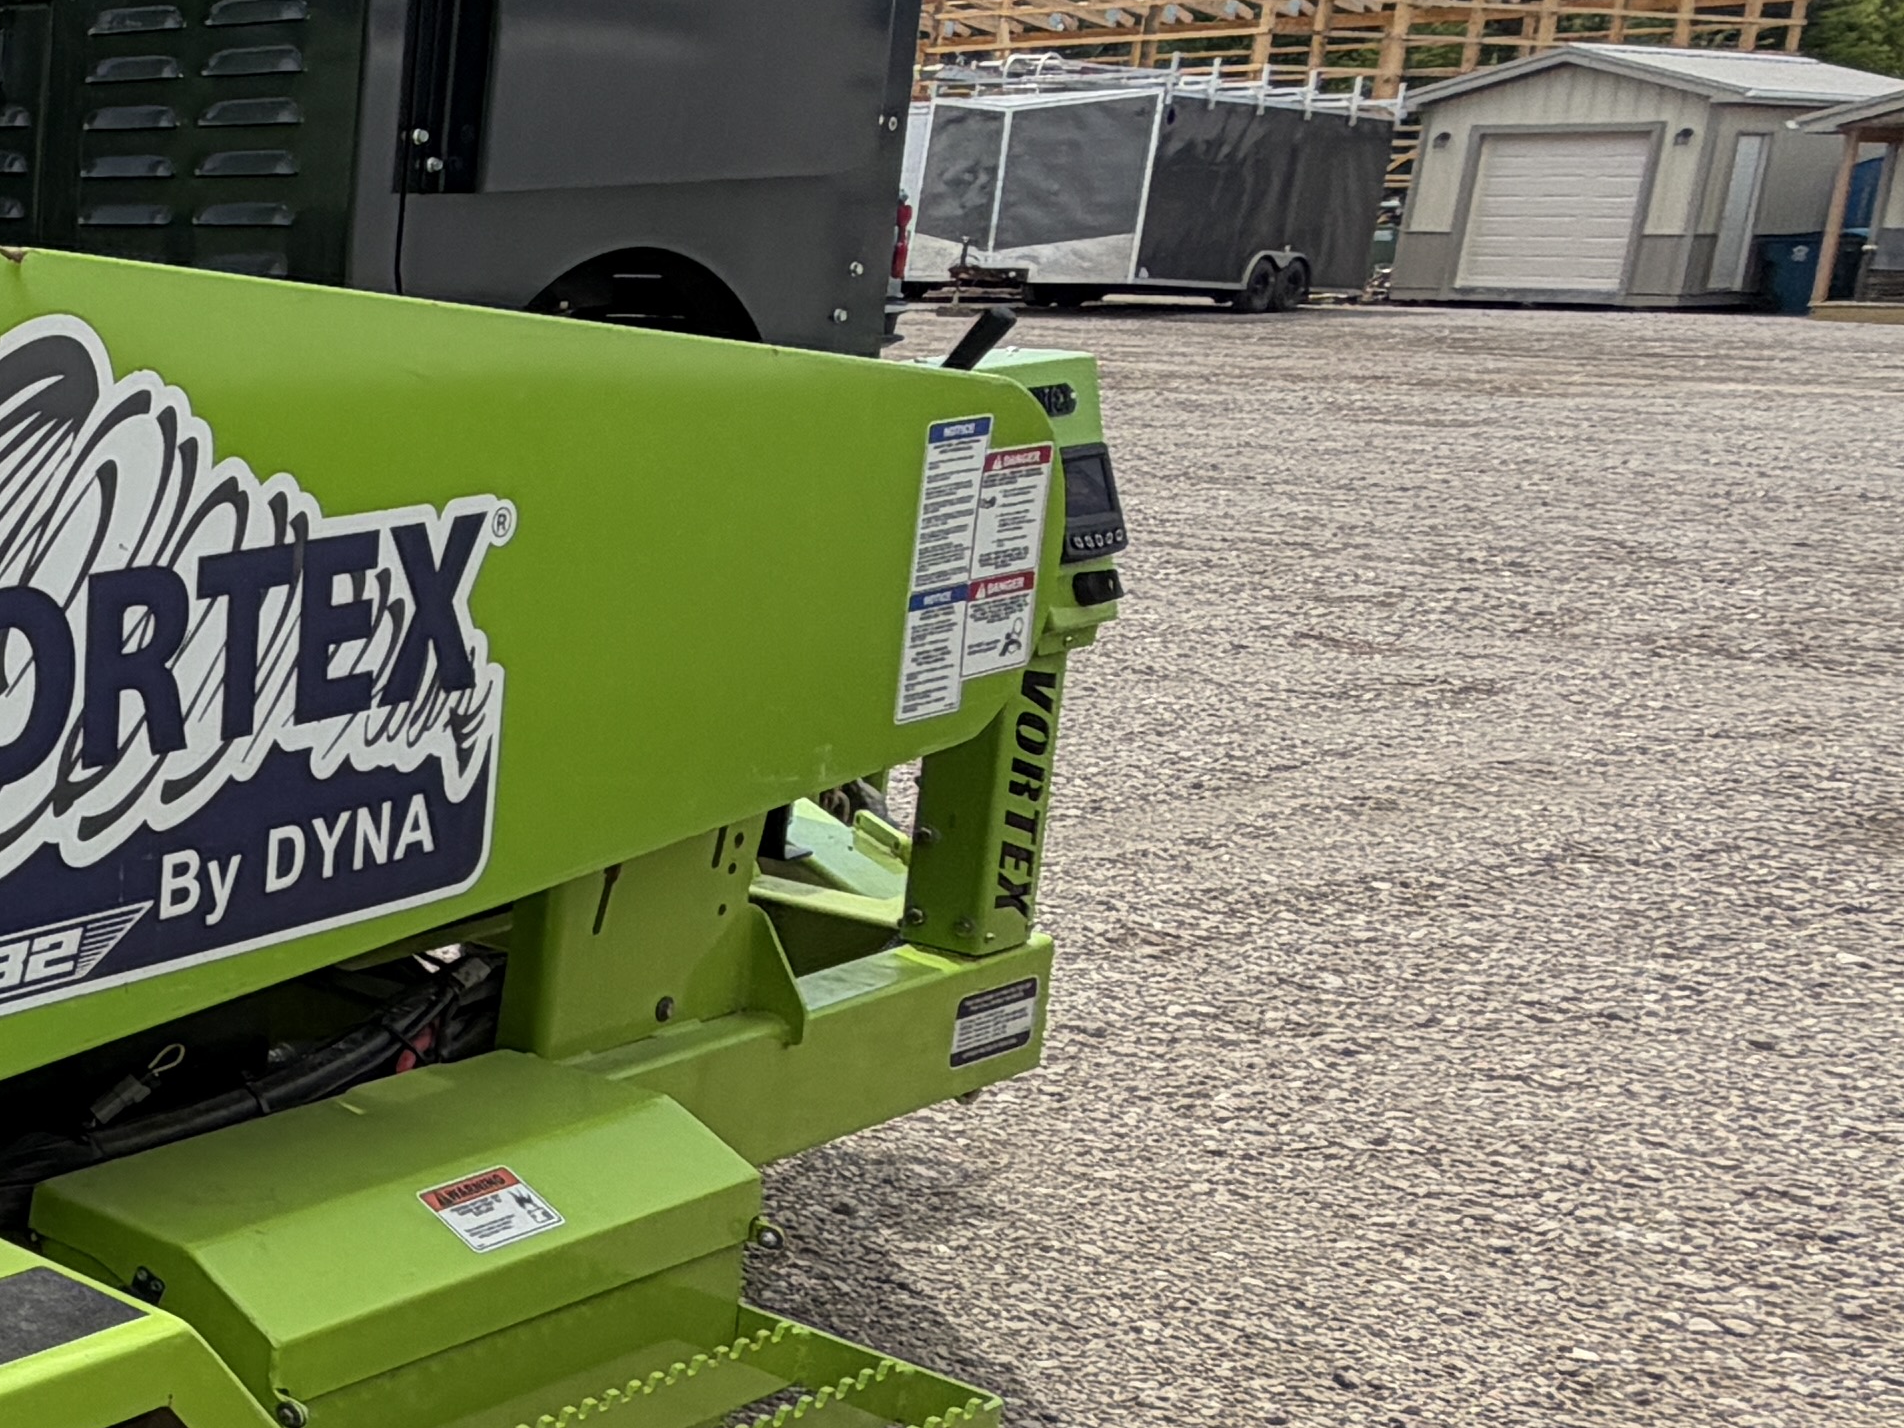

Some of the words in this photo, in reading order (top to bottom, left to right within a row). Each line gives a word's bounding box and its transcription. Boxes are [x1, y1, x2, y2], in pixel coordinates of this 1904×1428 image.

[159, 849, 242, 926] By
[266, 793, 436, 894] DYNA
[994, 669, 1057, 918] VORTEX
[446, 1174, 506, 1201] WARNING
